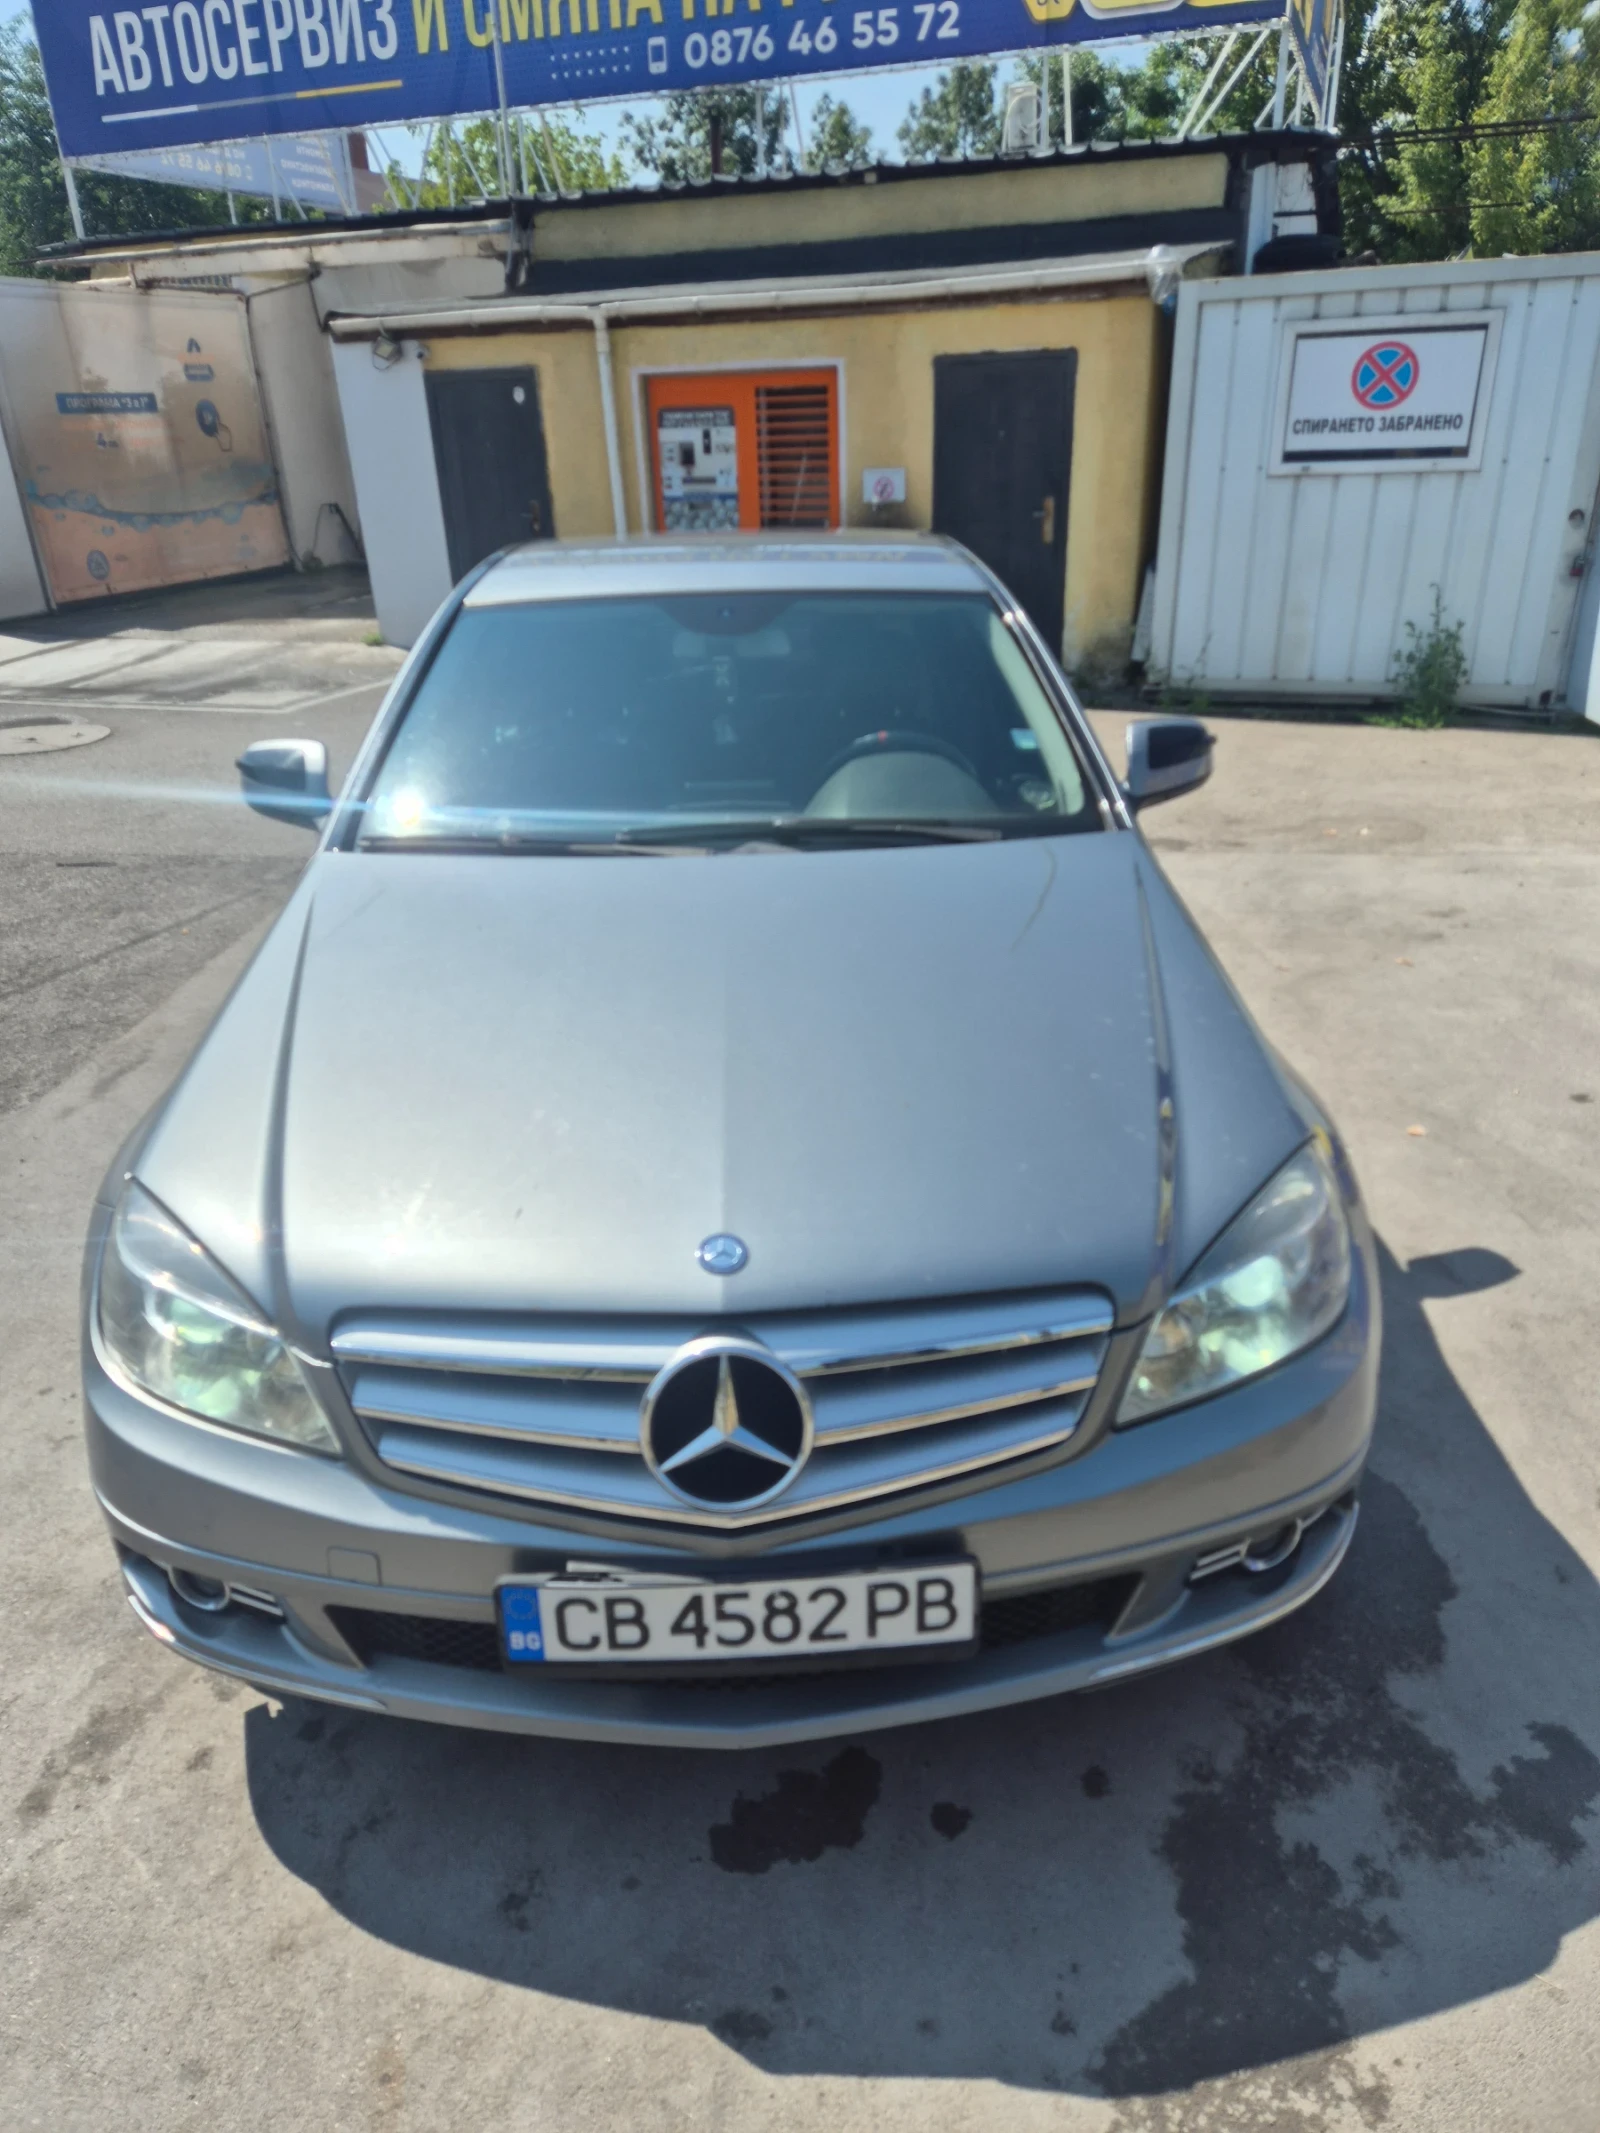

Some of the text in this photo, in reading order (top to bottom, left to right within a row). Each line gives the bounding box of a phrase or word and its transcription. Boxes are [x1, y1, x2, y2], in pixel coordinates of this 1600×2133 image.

[88, 0, 398, 96] АВТОСЕРВИЗ
[684, 0, 960, 69] 0876 46 55 72
[1292, 413, 1464, 435] СПИРАНЕТО ЗАБРАНЕНО
[509, 1630, 542, 1651] BG
[554, 1577, 958, 1652] CB 4582 PB
